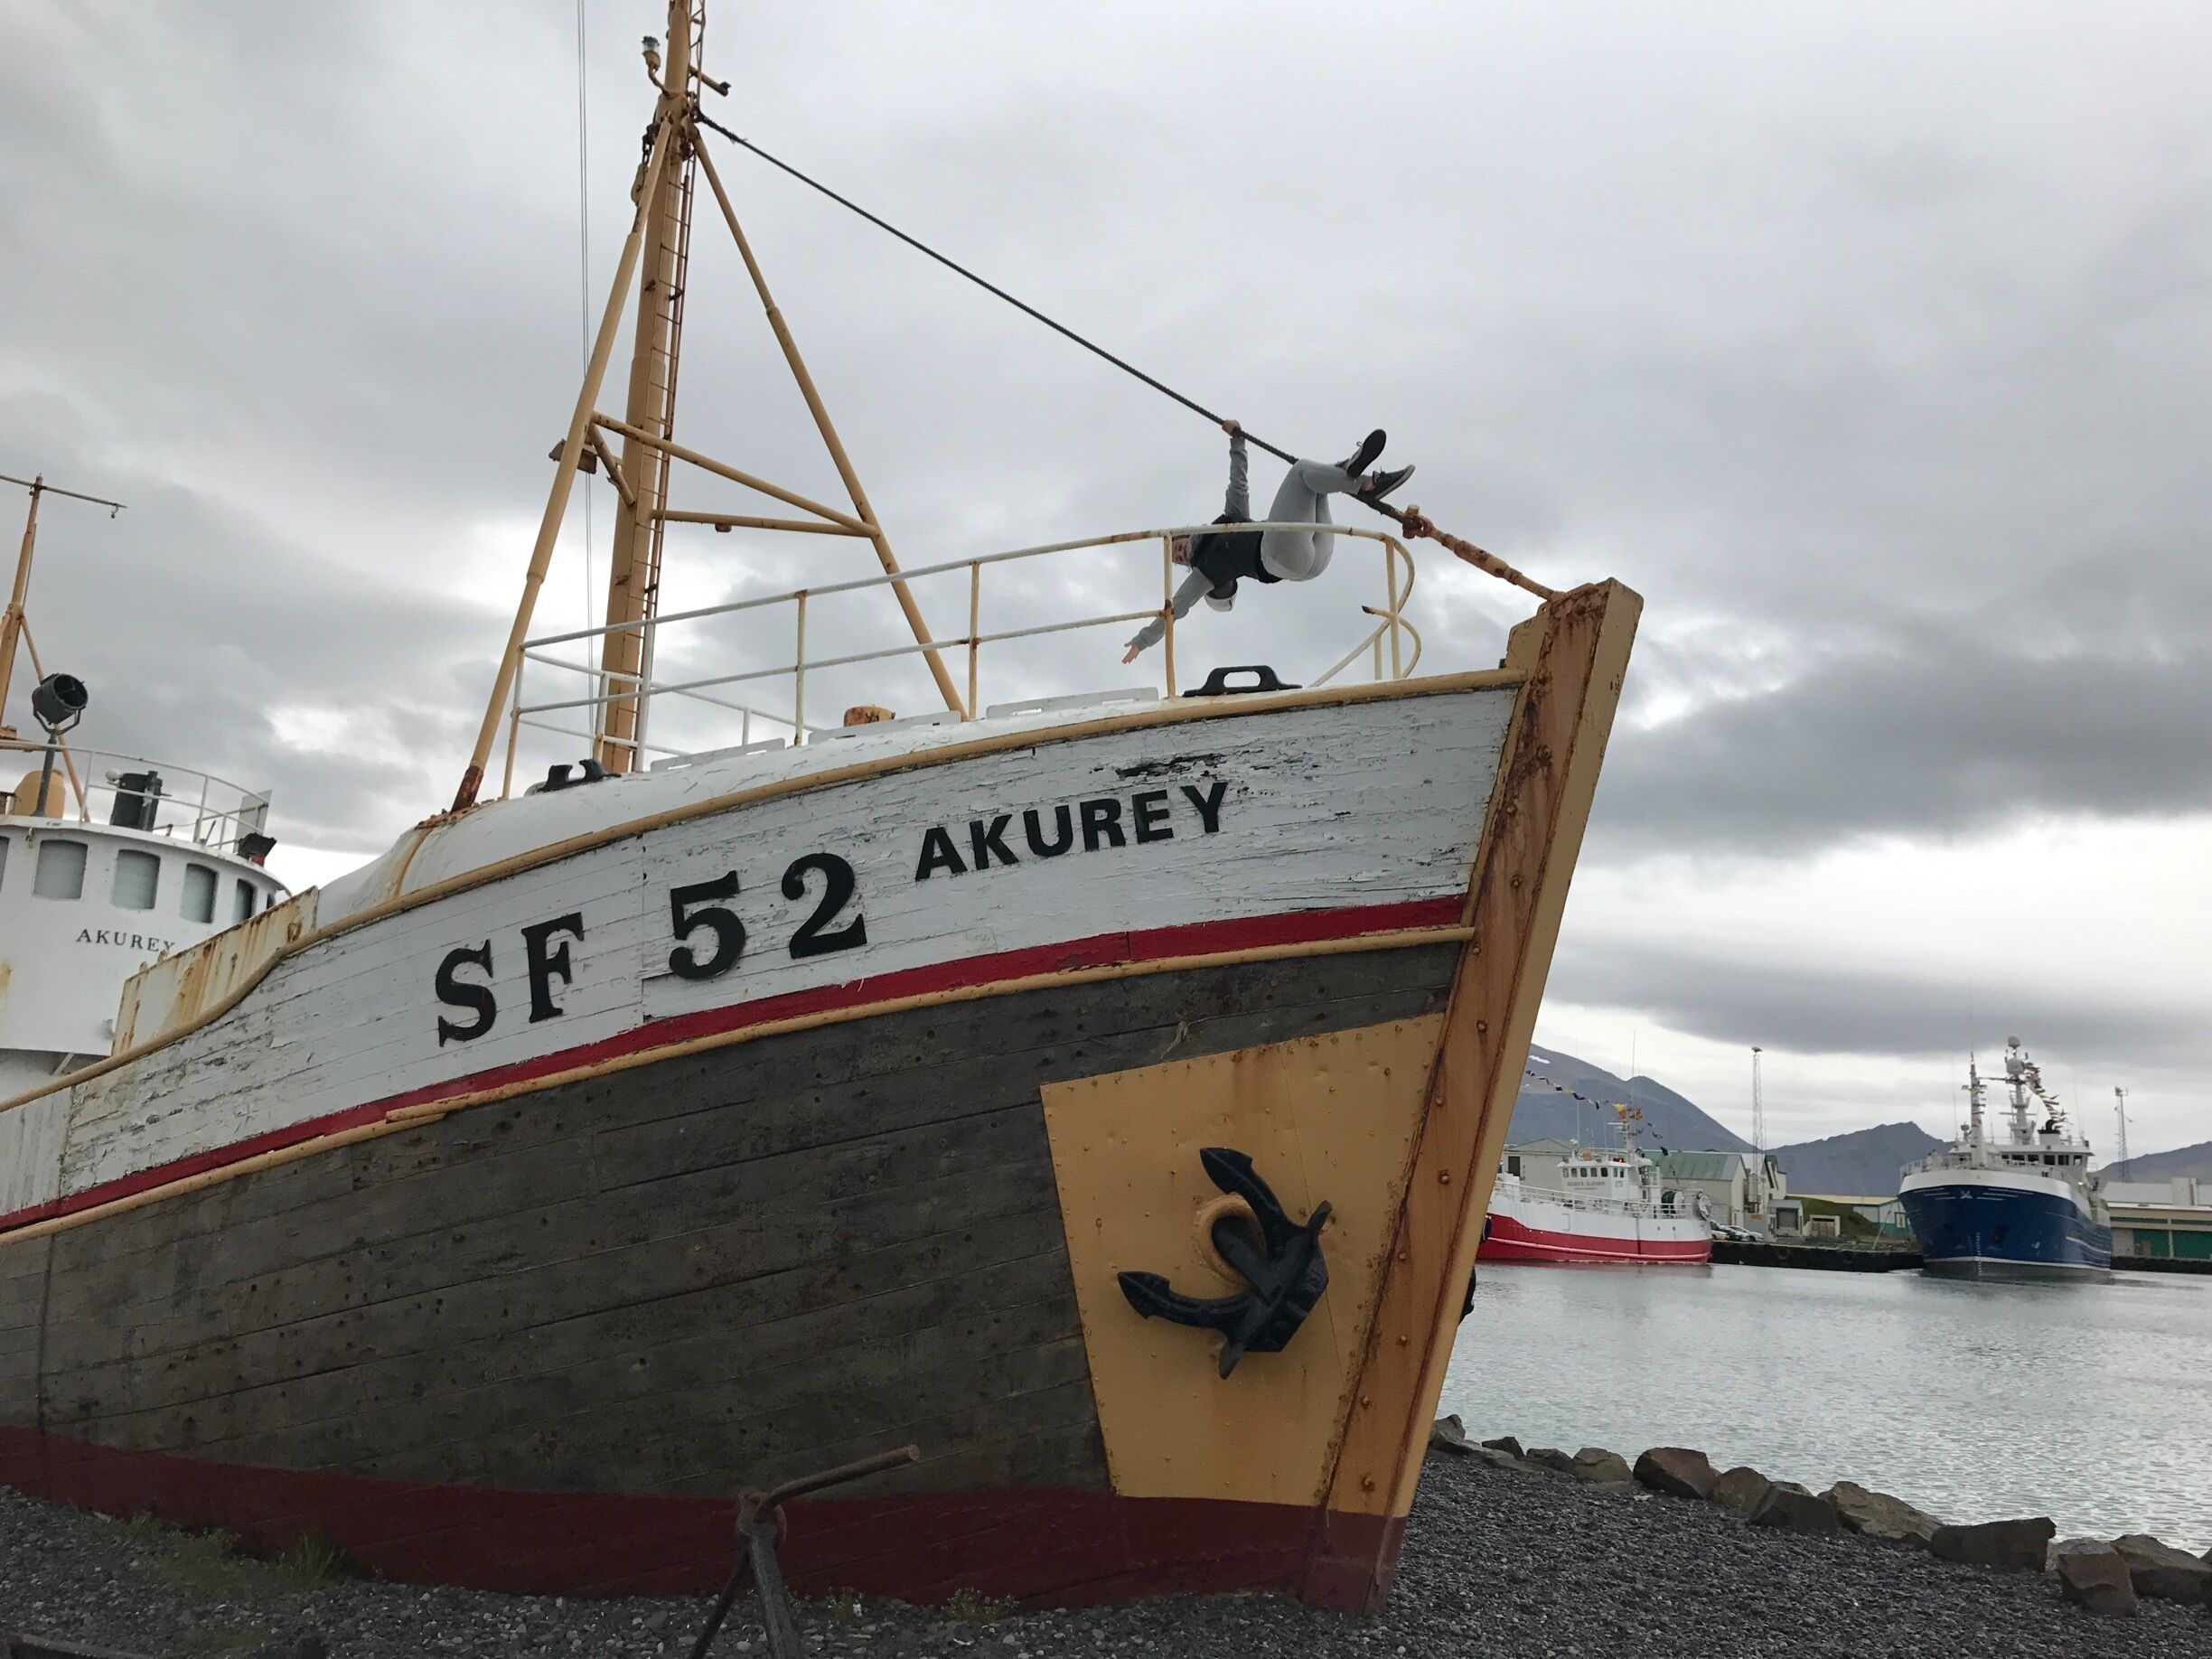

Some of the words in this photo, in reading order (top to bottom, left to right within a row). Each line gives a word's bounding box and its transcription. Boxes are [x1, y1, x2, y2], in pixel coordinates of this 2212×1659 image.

[915, 782, 1228, 882] AKUREY
[76, 928, 175, 952] AKUREY
[435, 912, 585, 1048] SF
[669, 852, 867, 980] 52
